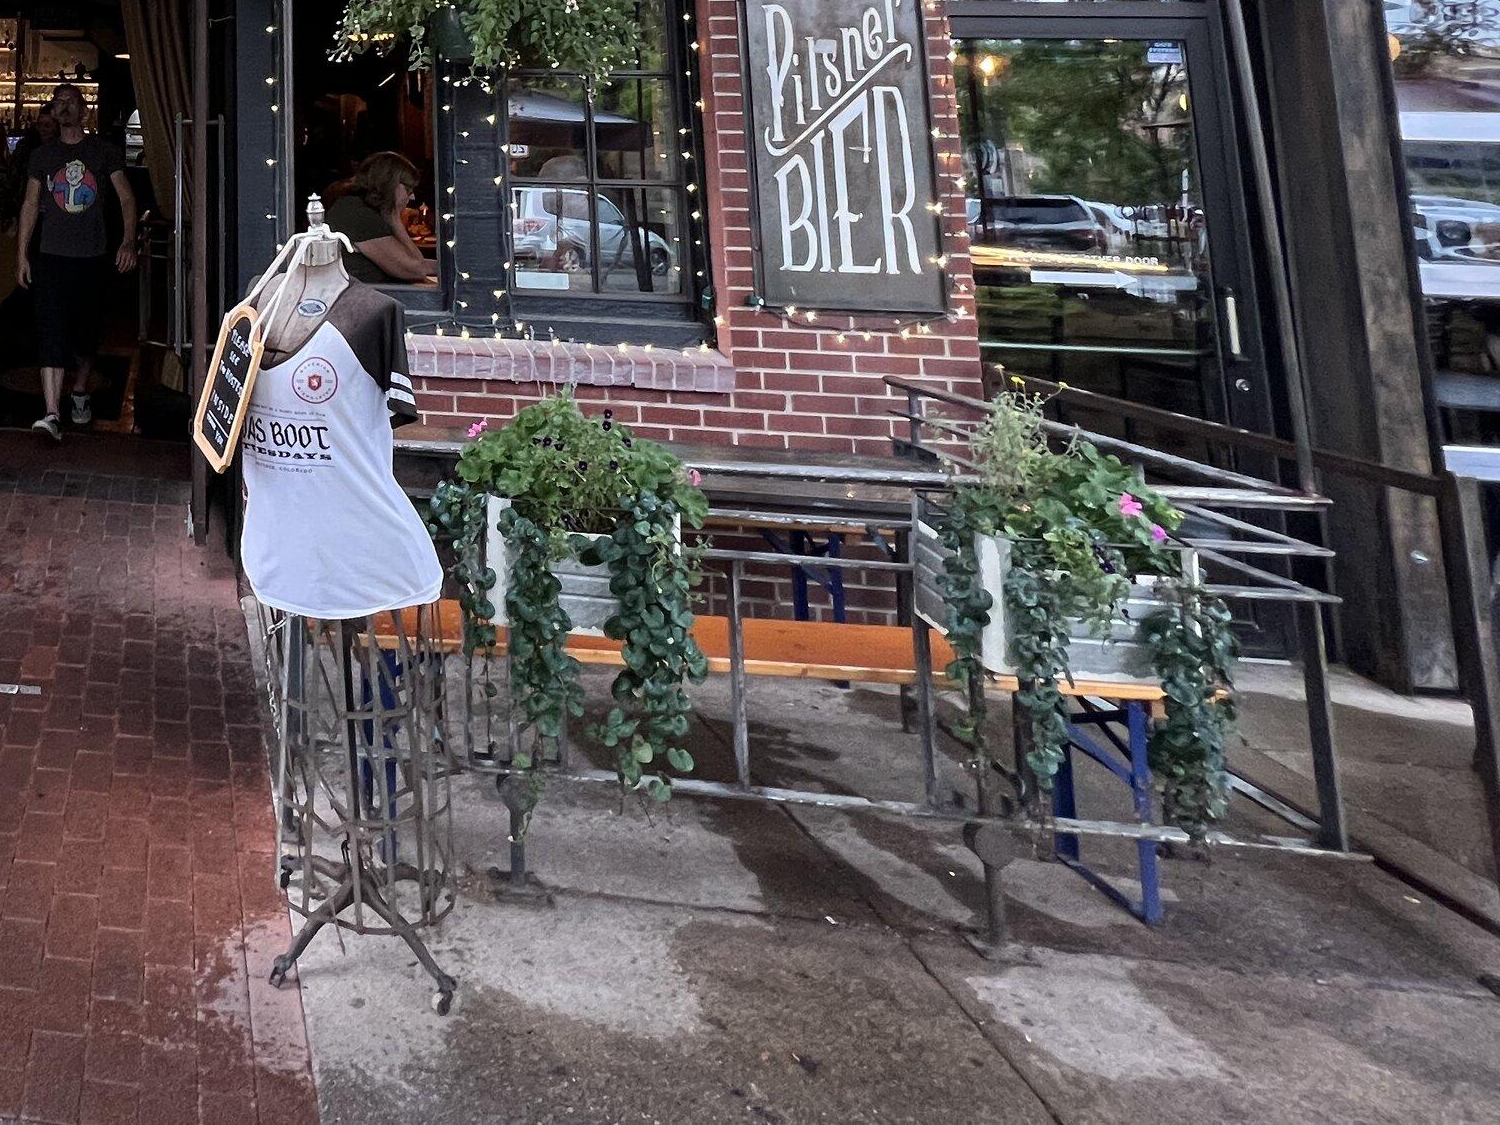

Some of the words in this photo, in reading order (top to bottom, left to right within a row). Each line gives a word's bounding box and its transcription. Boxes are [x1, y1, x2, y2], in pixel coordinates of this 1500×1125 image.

[773, 85, 923, 275] BIER
[211, 390, 234, 425] INSIDE
[269, 421, 331, 450] BOOT
